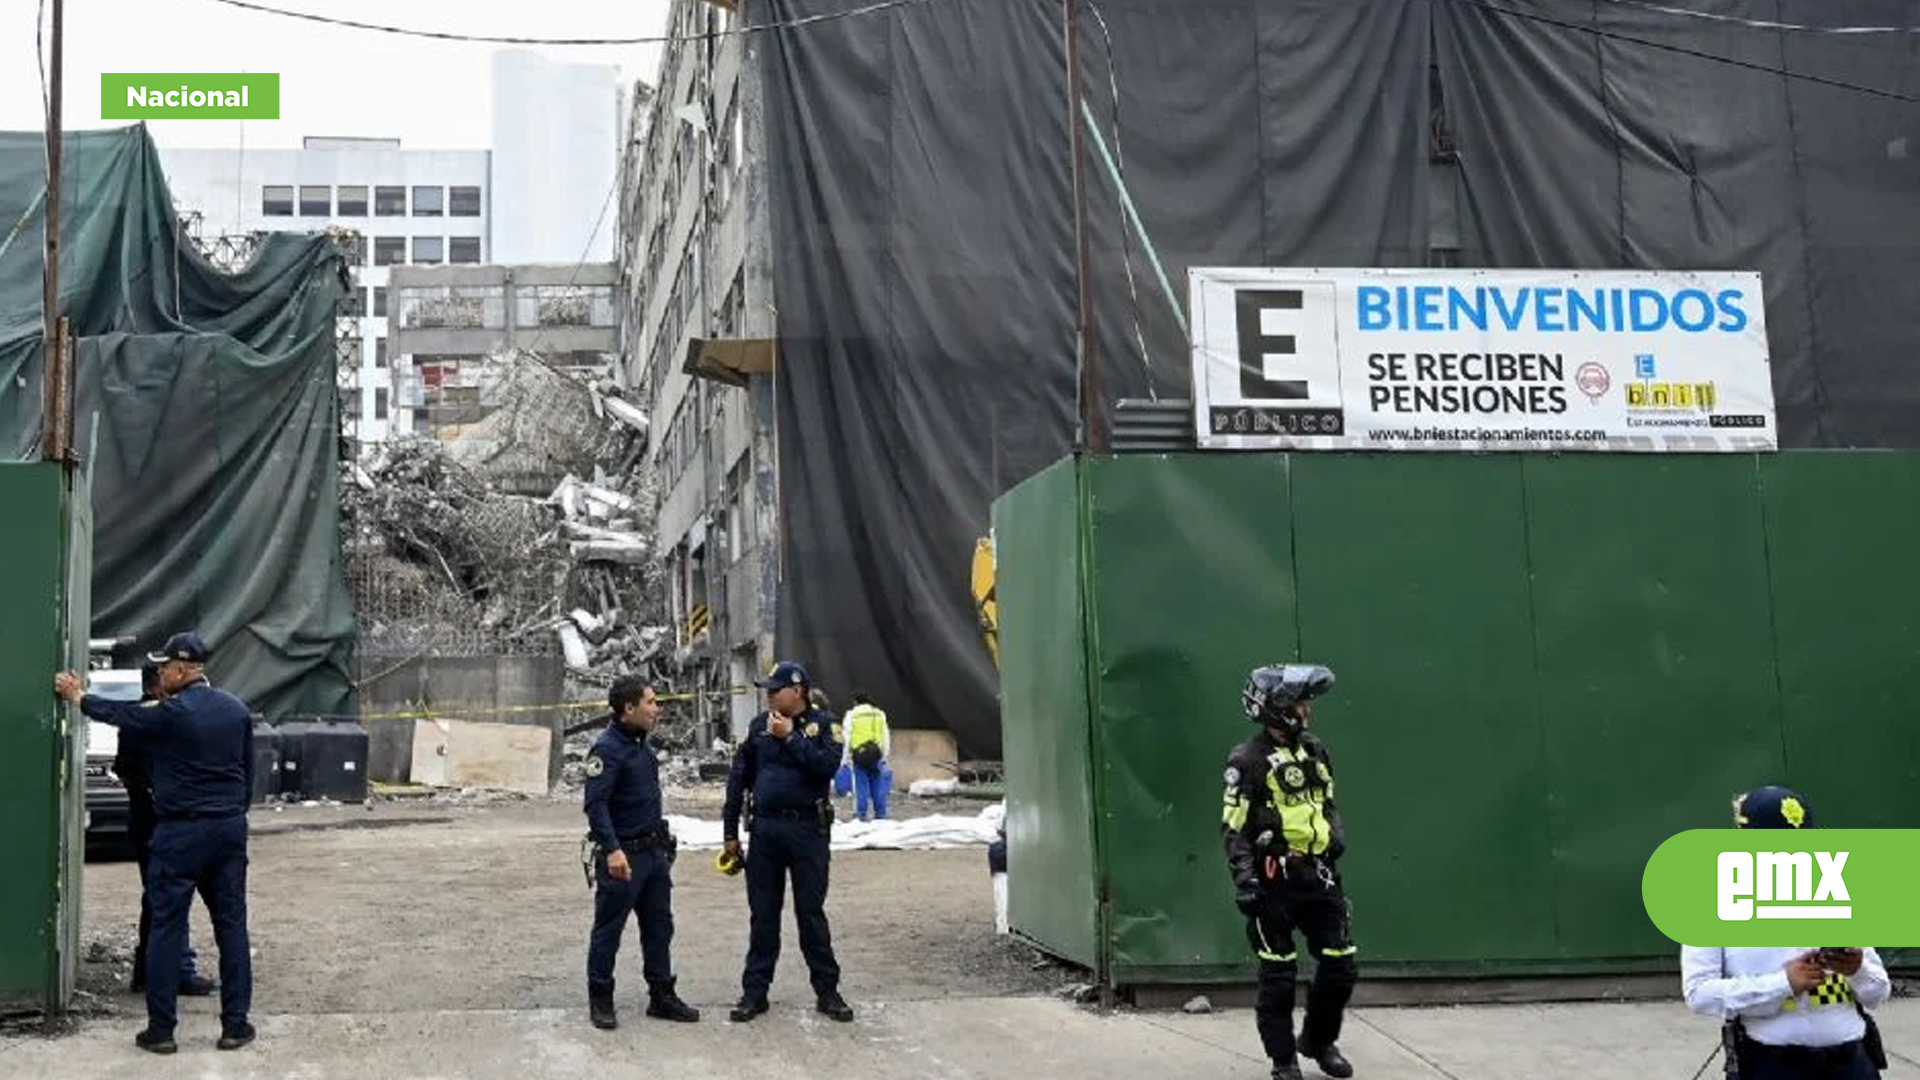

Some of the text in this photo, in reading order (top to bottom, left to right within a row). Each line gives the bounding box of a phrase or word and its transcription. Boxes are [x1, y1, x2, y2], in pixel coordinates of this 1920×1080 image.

[1357, 286, 1748, 333] BIENVENIDOS
[1235, 289, 1310, 399] E
[1368, 353, 1565, 382] SE RECIBEN
[1369, 385, 1568, 414] PENSIONES
[1214, 409, 1341, 433] PÚBLICO
[1368, 427, 1608, 442] www.bniestacionamientos.com
